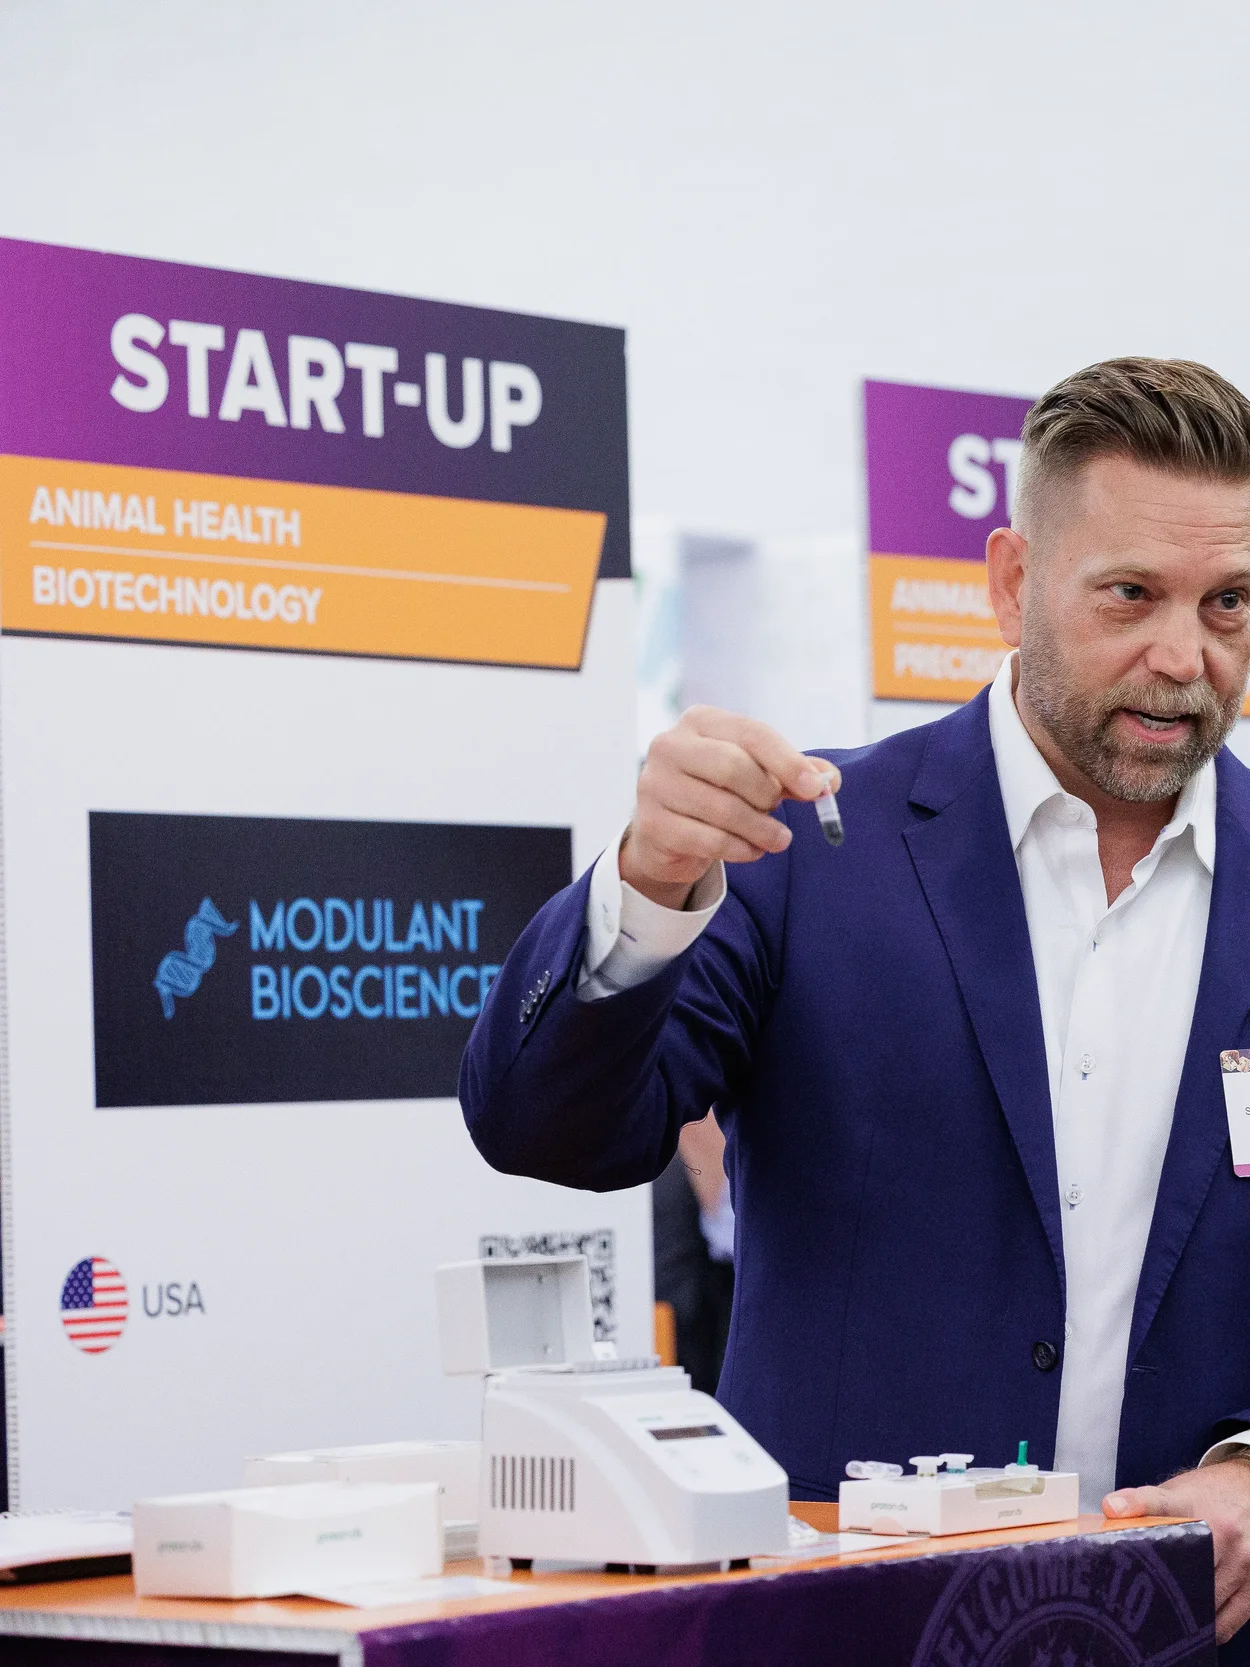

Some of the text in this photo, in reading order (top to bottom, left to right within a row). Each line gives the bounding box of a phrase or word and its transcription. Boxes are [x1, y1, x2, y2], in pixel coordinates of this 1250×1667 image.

[110, 312, 543, 452] START-UP
[29, 485, 300, 547] ANIMAL HEALTH
[32, 564, 323, 625] BIOTECHNOLOGY
[250, 898, 484, 952] MODULANT
[251, 964, 502, 1020] BIOSCIENCE
[142, 1282, 206, 1318] USA
[937, 1549, 1156, 1667] ELCOME TO
